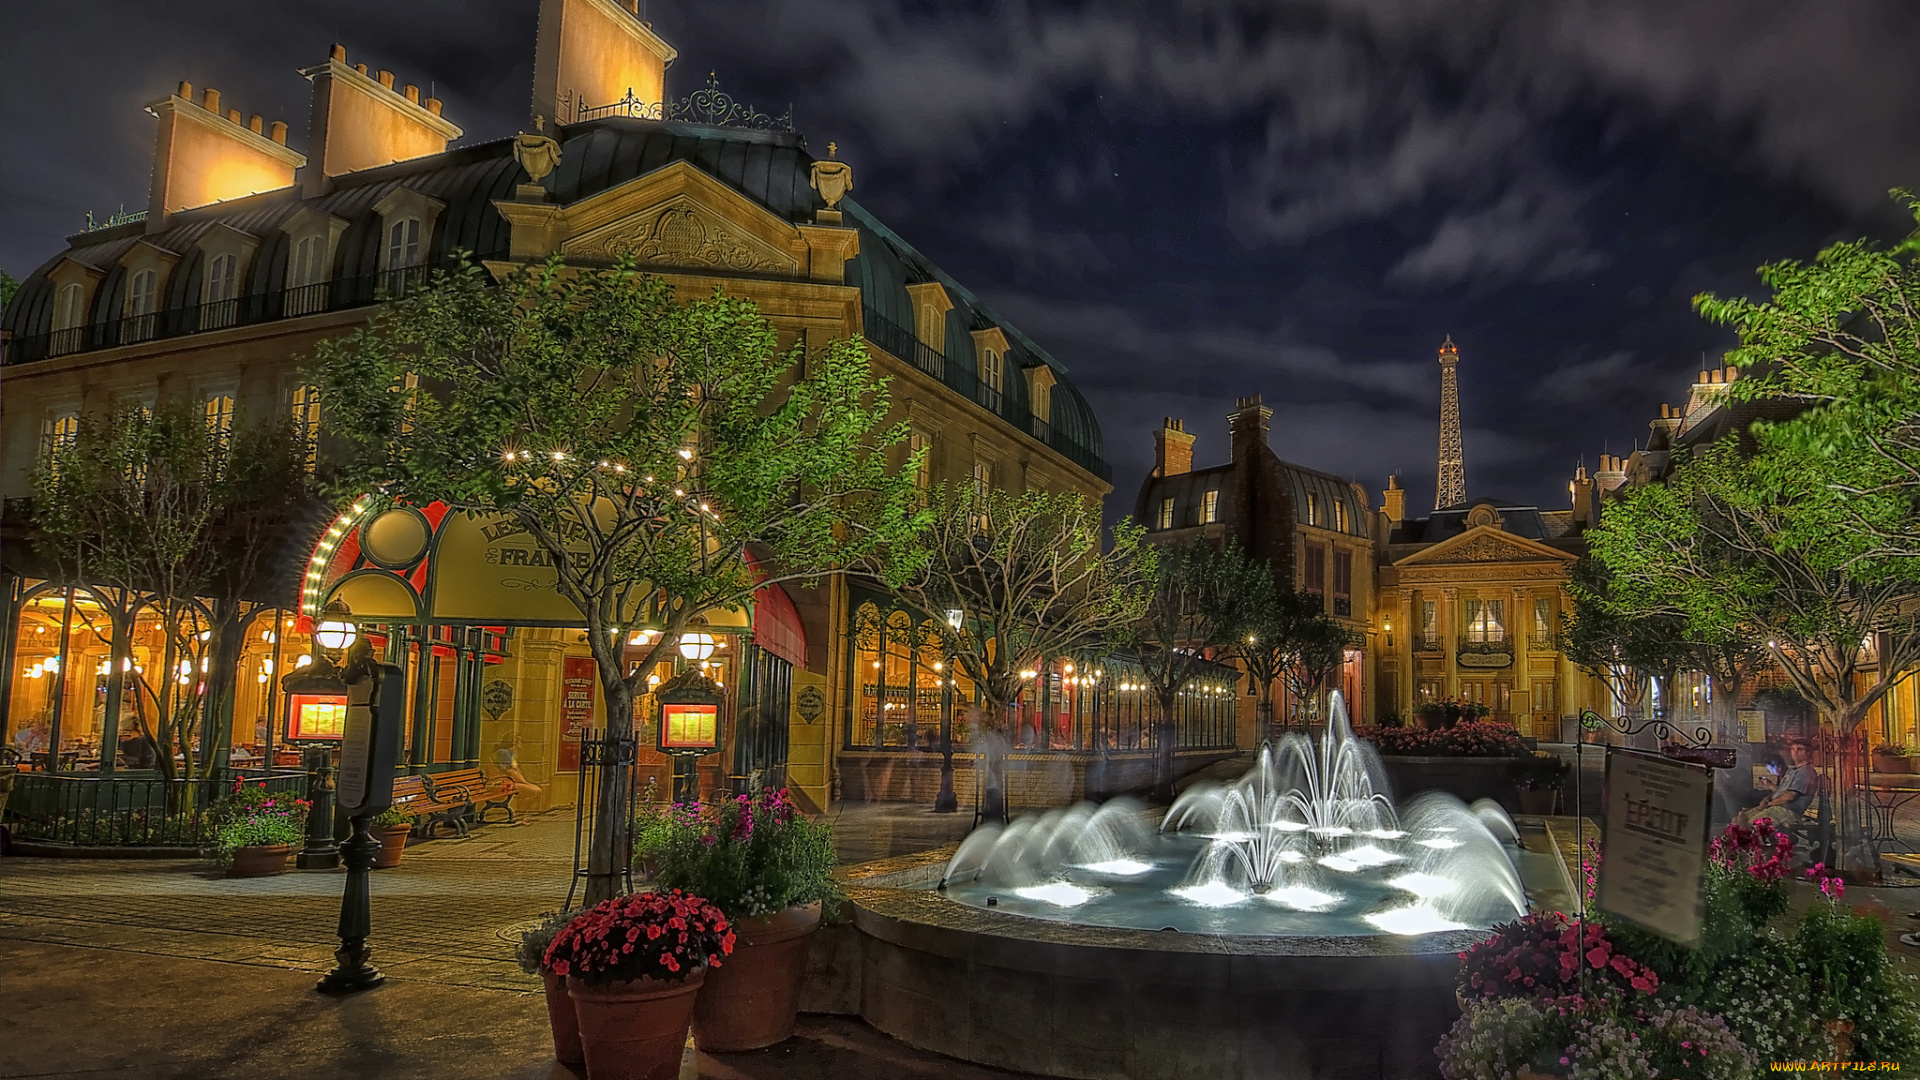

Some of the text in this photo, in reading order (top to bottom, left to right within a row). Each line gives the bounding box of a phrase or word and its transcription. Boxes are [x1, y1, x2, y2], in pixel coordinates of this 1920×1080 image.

[568, 691, 588, 700] SERVICE
[568, 700, 575, 708] LA
[576, 700, 592, 708] CARTE
